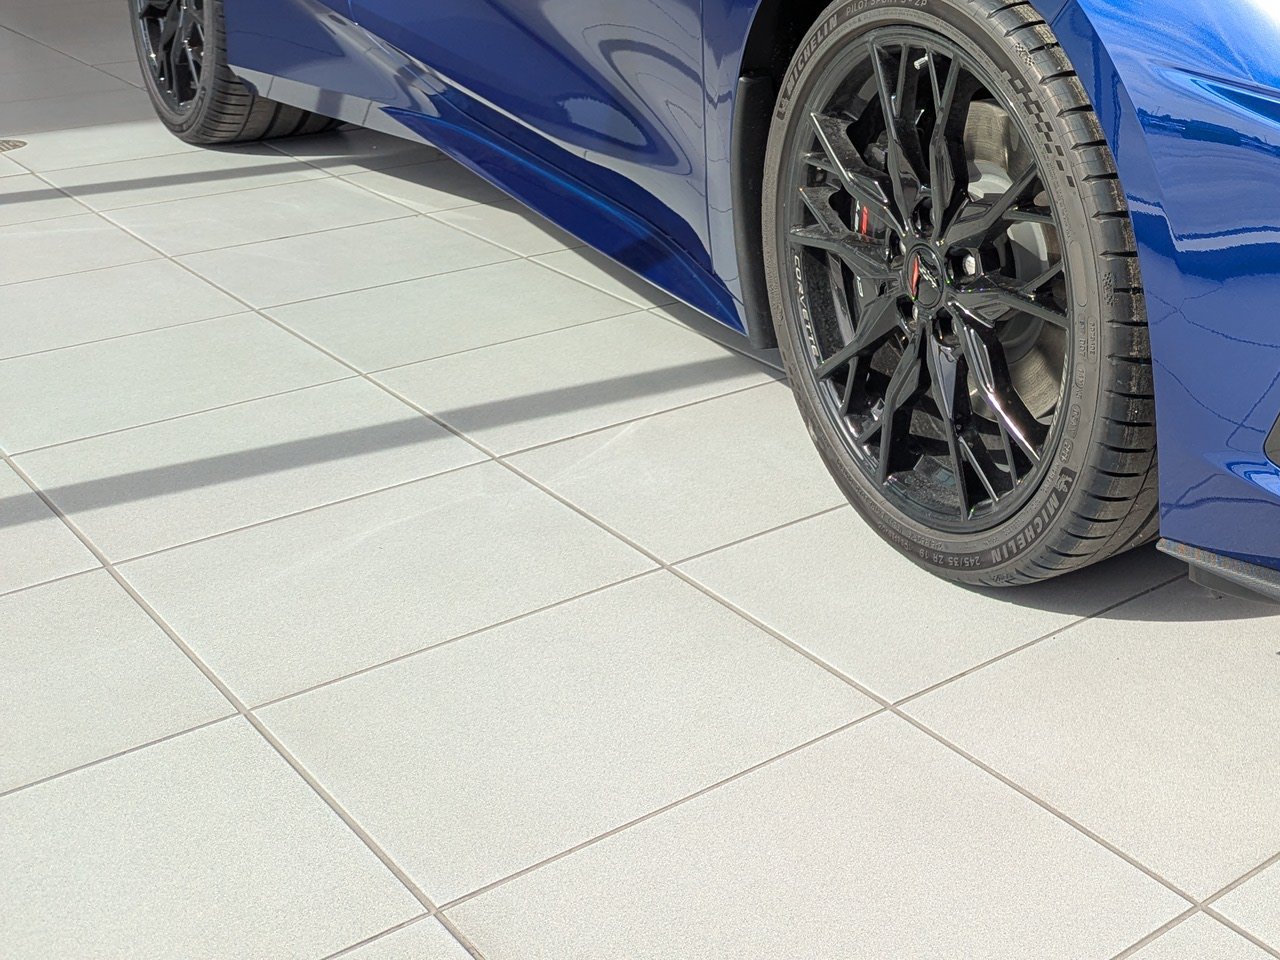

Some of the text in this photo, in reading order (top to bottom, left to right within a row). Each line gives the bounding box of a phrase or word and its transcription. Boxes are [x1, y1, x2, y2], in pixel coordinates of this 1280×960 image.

[786, 14, 838, 96] MICHELIN
[794, 255, 819, 357] CORVETTE
[918, 493, 1060, 568] MICHELIN 245/35 ZR 19
